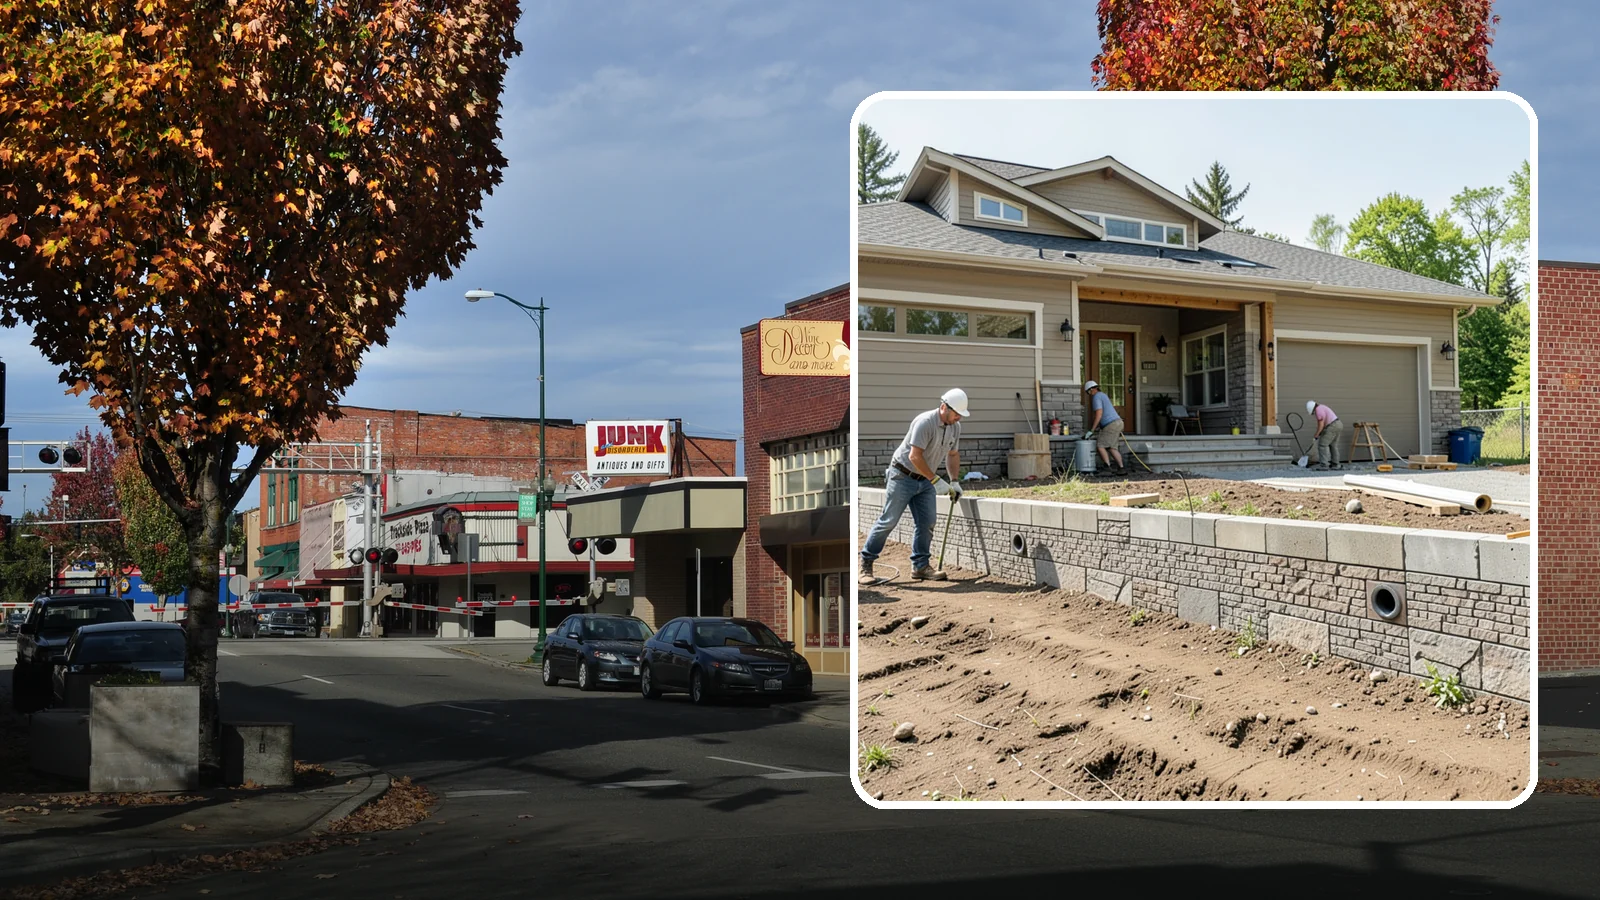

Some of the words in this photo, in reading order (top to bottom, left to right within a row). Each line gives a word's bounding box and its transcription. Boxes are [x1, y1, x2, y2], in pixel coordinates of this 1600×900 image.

[764, 327, 831, 365] Decor
[595, 425, 665, 457] JUNK
[607, 446, 646, 454] DISORDERLY
[596, 461, 628, 470] ANTIQUES
[631, 461, 644, 470] AND
[647, 460, 666, 470] GIFTS
[390, 521, 413, 540] Trackside
[414, 519, 429, 535] Pizza
